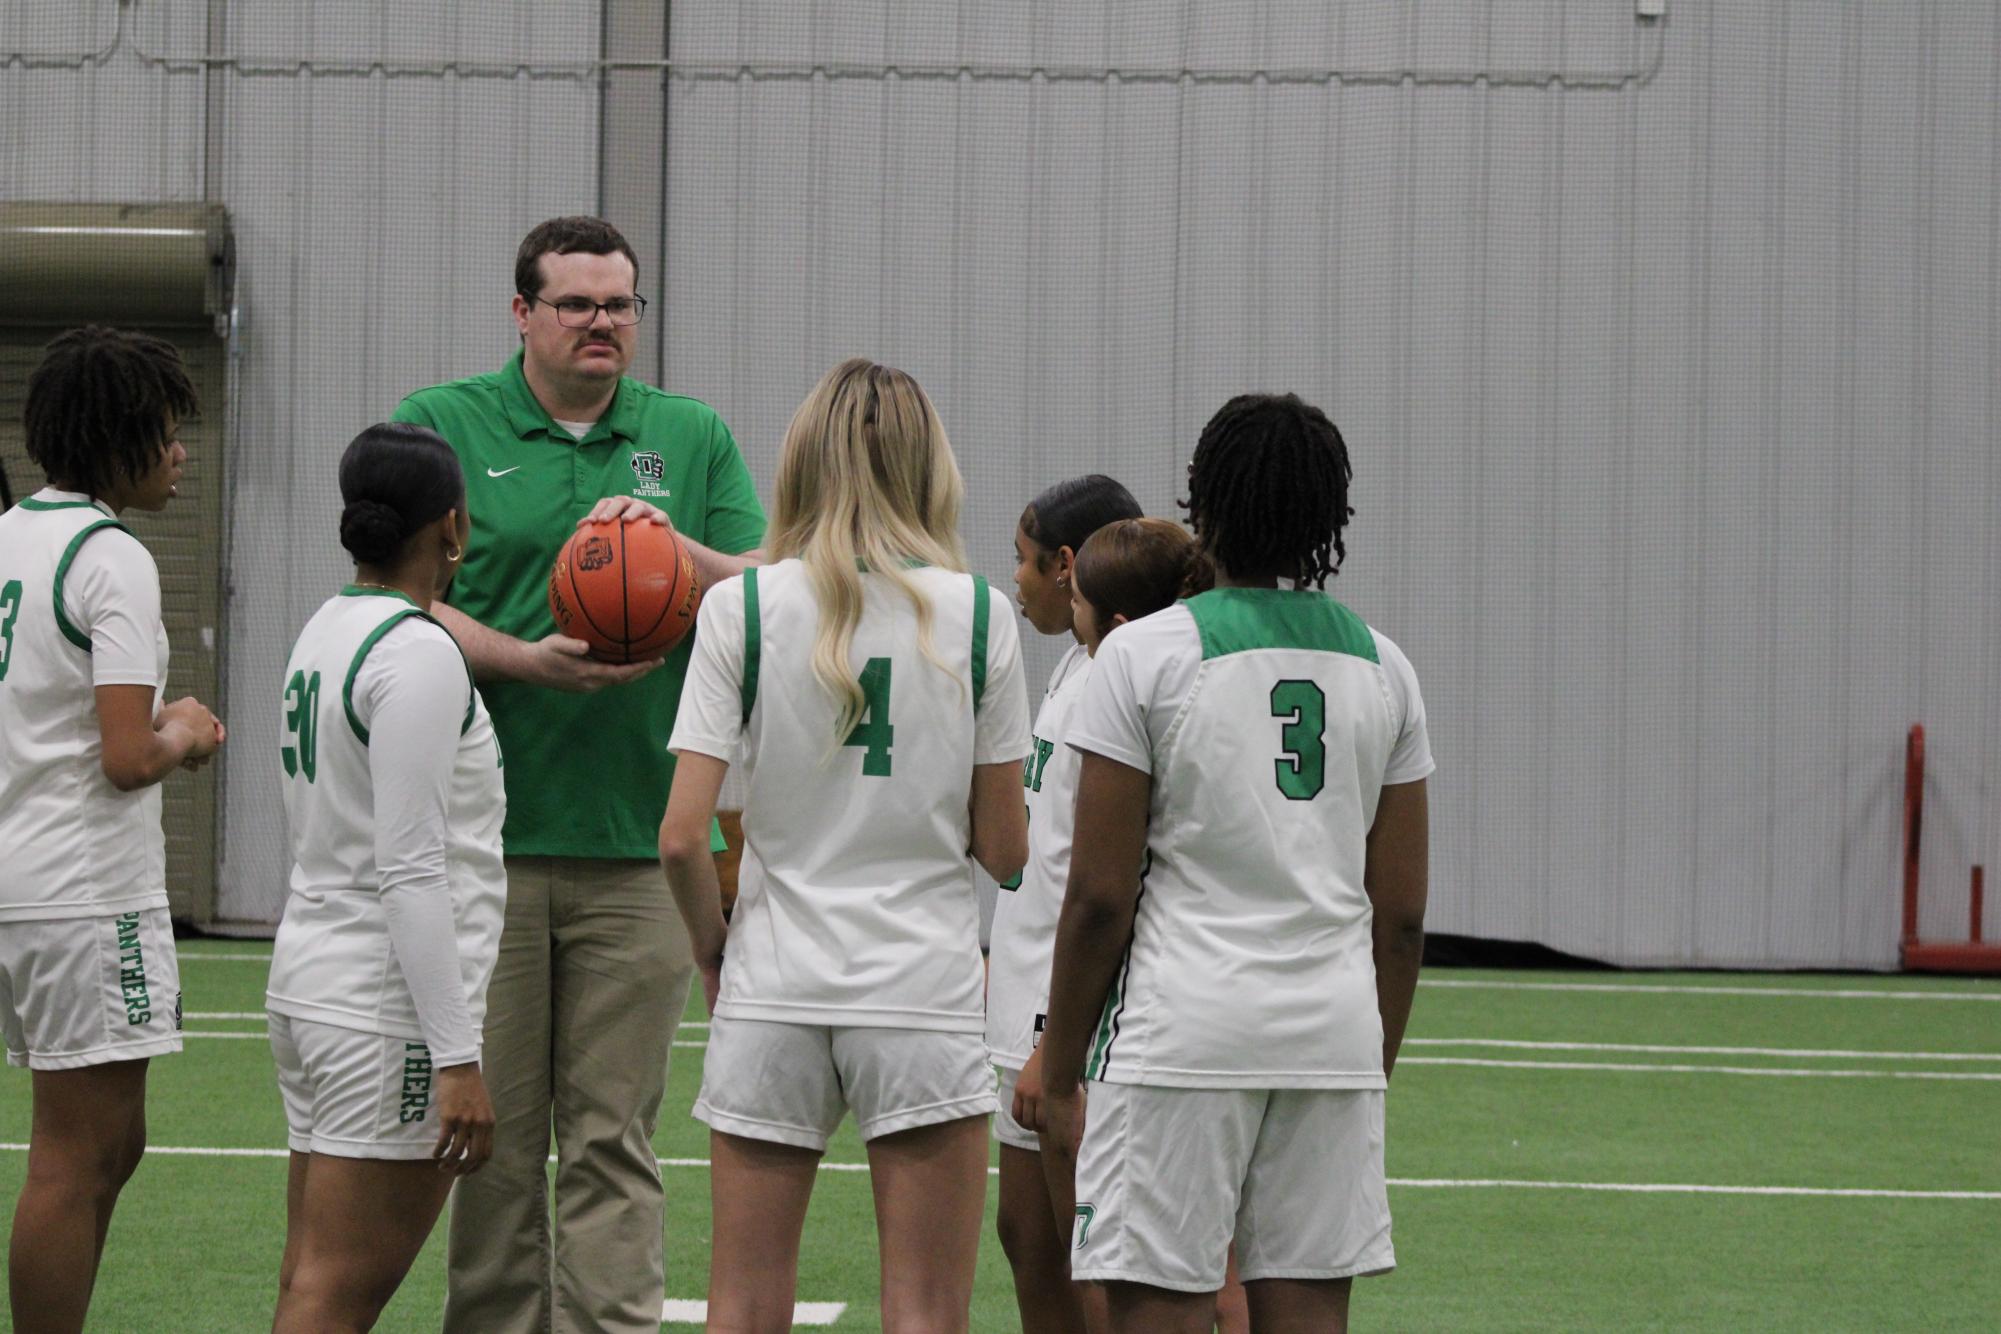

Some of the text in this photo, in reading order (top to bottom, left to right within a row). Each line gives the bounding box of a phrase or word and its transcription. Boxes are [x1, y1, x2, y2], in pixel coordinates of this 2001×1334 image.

[633, 488, 670, 497] PANTHERS
[640, 481, 660, 490] LADY
[0, 579, 23, 682] 3
[835, 657, 894, 777] 4
[1270, 680, 1326, 801] 3
[115, 911, 152, 1025] PANTHERS
